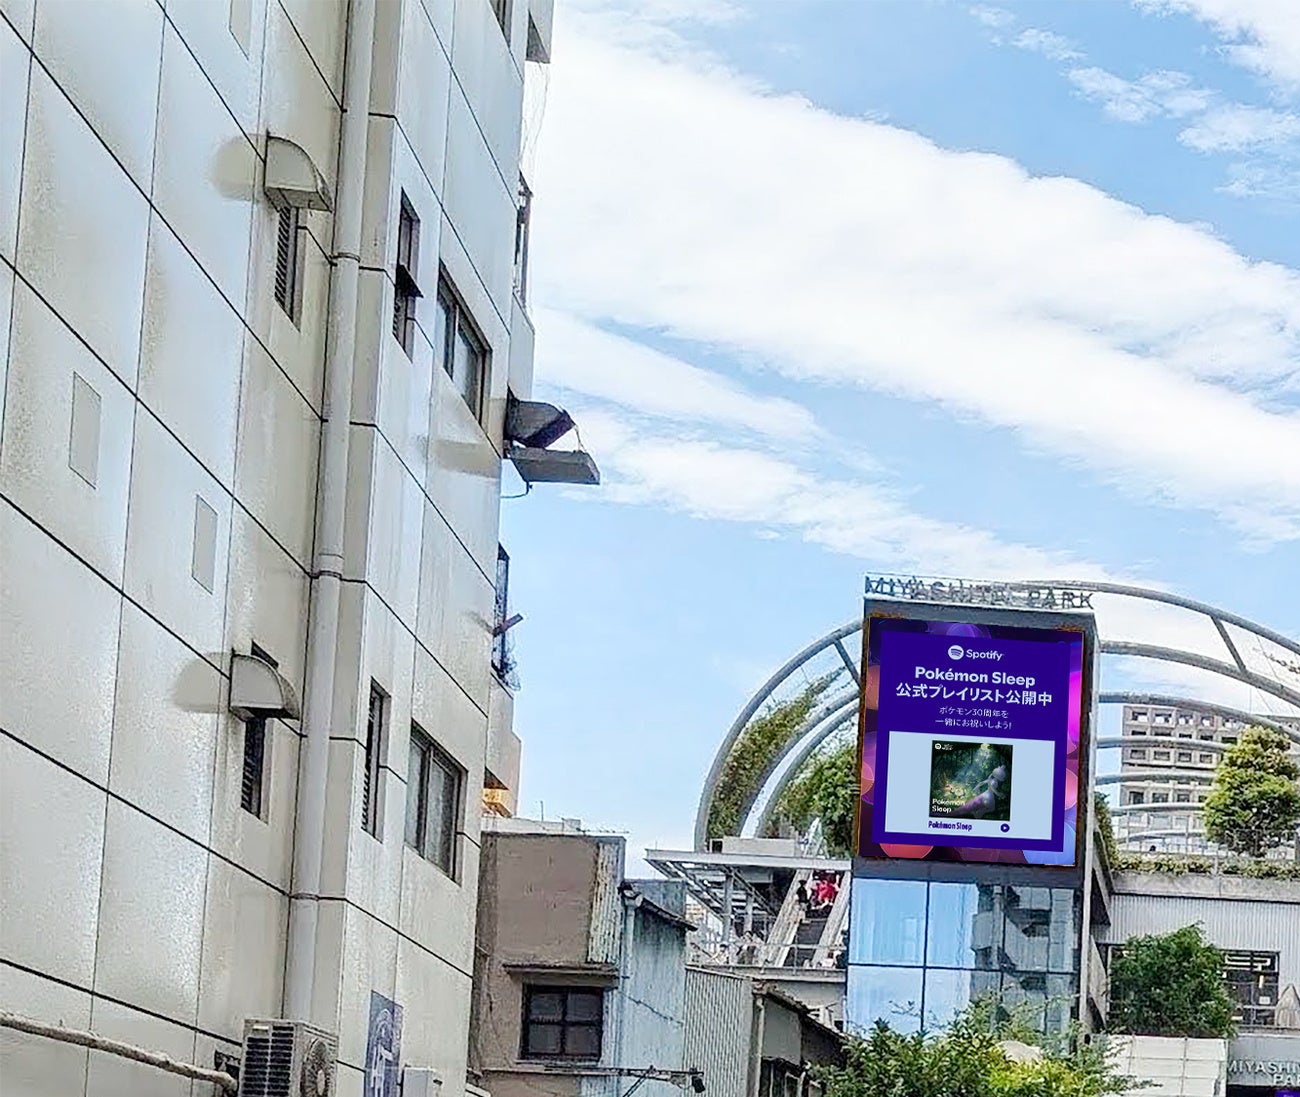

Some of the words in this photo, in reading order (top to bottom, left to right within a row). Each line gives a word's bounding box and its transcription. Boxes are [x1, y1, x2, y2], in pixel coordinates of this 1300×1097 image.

[966, 649, 1003, 661] Spotify
[915, 666, 988, 683] Pokémon
[992, 672, 1035, 688] Sleep
[896, 682, 1052, 706] 公式プレイリスト公開中
